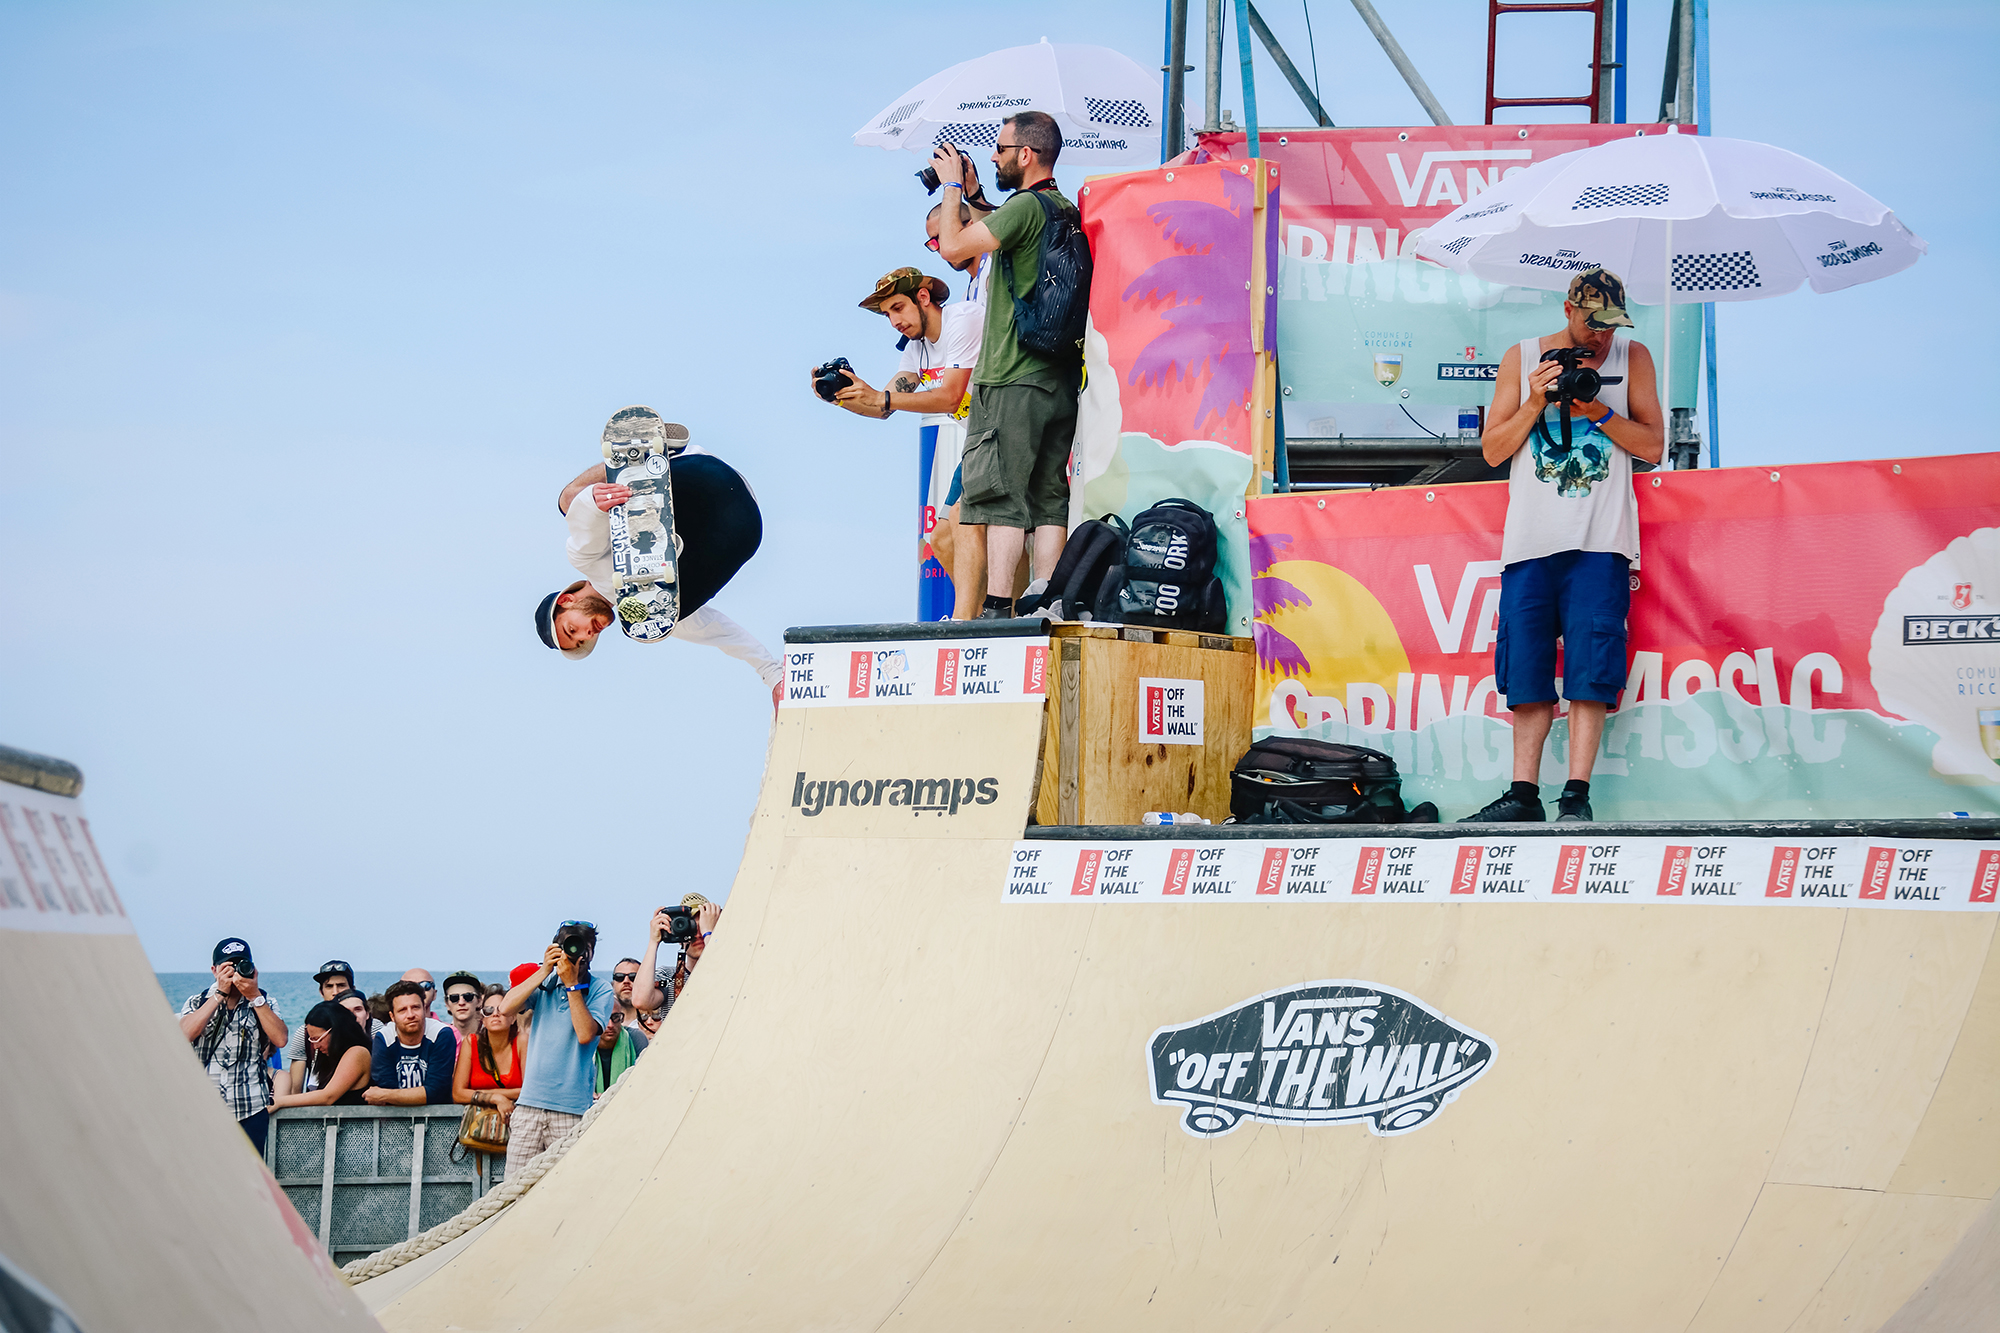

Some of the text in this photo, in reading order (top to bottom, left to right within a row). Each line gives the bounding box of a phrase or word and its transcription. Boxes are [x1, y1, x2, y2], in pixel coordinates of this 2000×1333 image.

[957, 99, 1031, 110] SPRING CLASSIC
[1750, 192, 1790, 200] SPRING
[1365, 331, 1399, 339] COMUNE
[1364, 340, 1413, 348] RICCIONE
[1441, 366, 1498, 377] BECK'S
[1164, 534, 1189, 570] ORK
[791, 670, 813, 682] THE
[964, 665, 987, 677] THE
[1957, 667, 2000, 679] COMU
[1959, 683, 1996, 695] RICC
[1167, 705, 1185, 717] THE
[791, 772, 999, 817] Ignoramps
[1014, 867, 1038, 878] THE
[1105, 866, 1129, 877] THE
[1197, 865, 1221, 877] THE
[1291, 865, 1316, 877] THE
[1388, 864, 1413, 876] THE
[1487, 863, 1513, 875] THE
[1590, 863, 1617, 875] THE
[1696, 865, 1723, 877] THE
[1805, 866, 1834, 878] THE
[1899, 868, 1928, 881] THE
[1262, 996, 1382, 1047] VANS
[1256, 1047, 1347, 1108] THE
